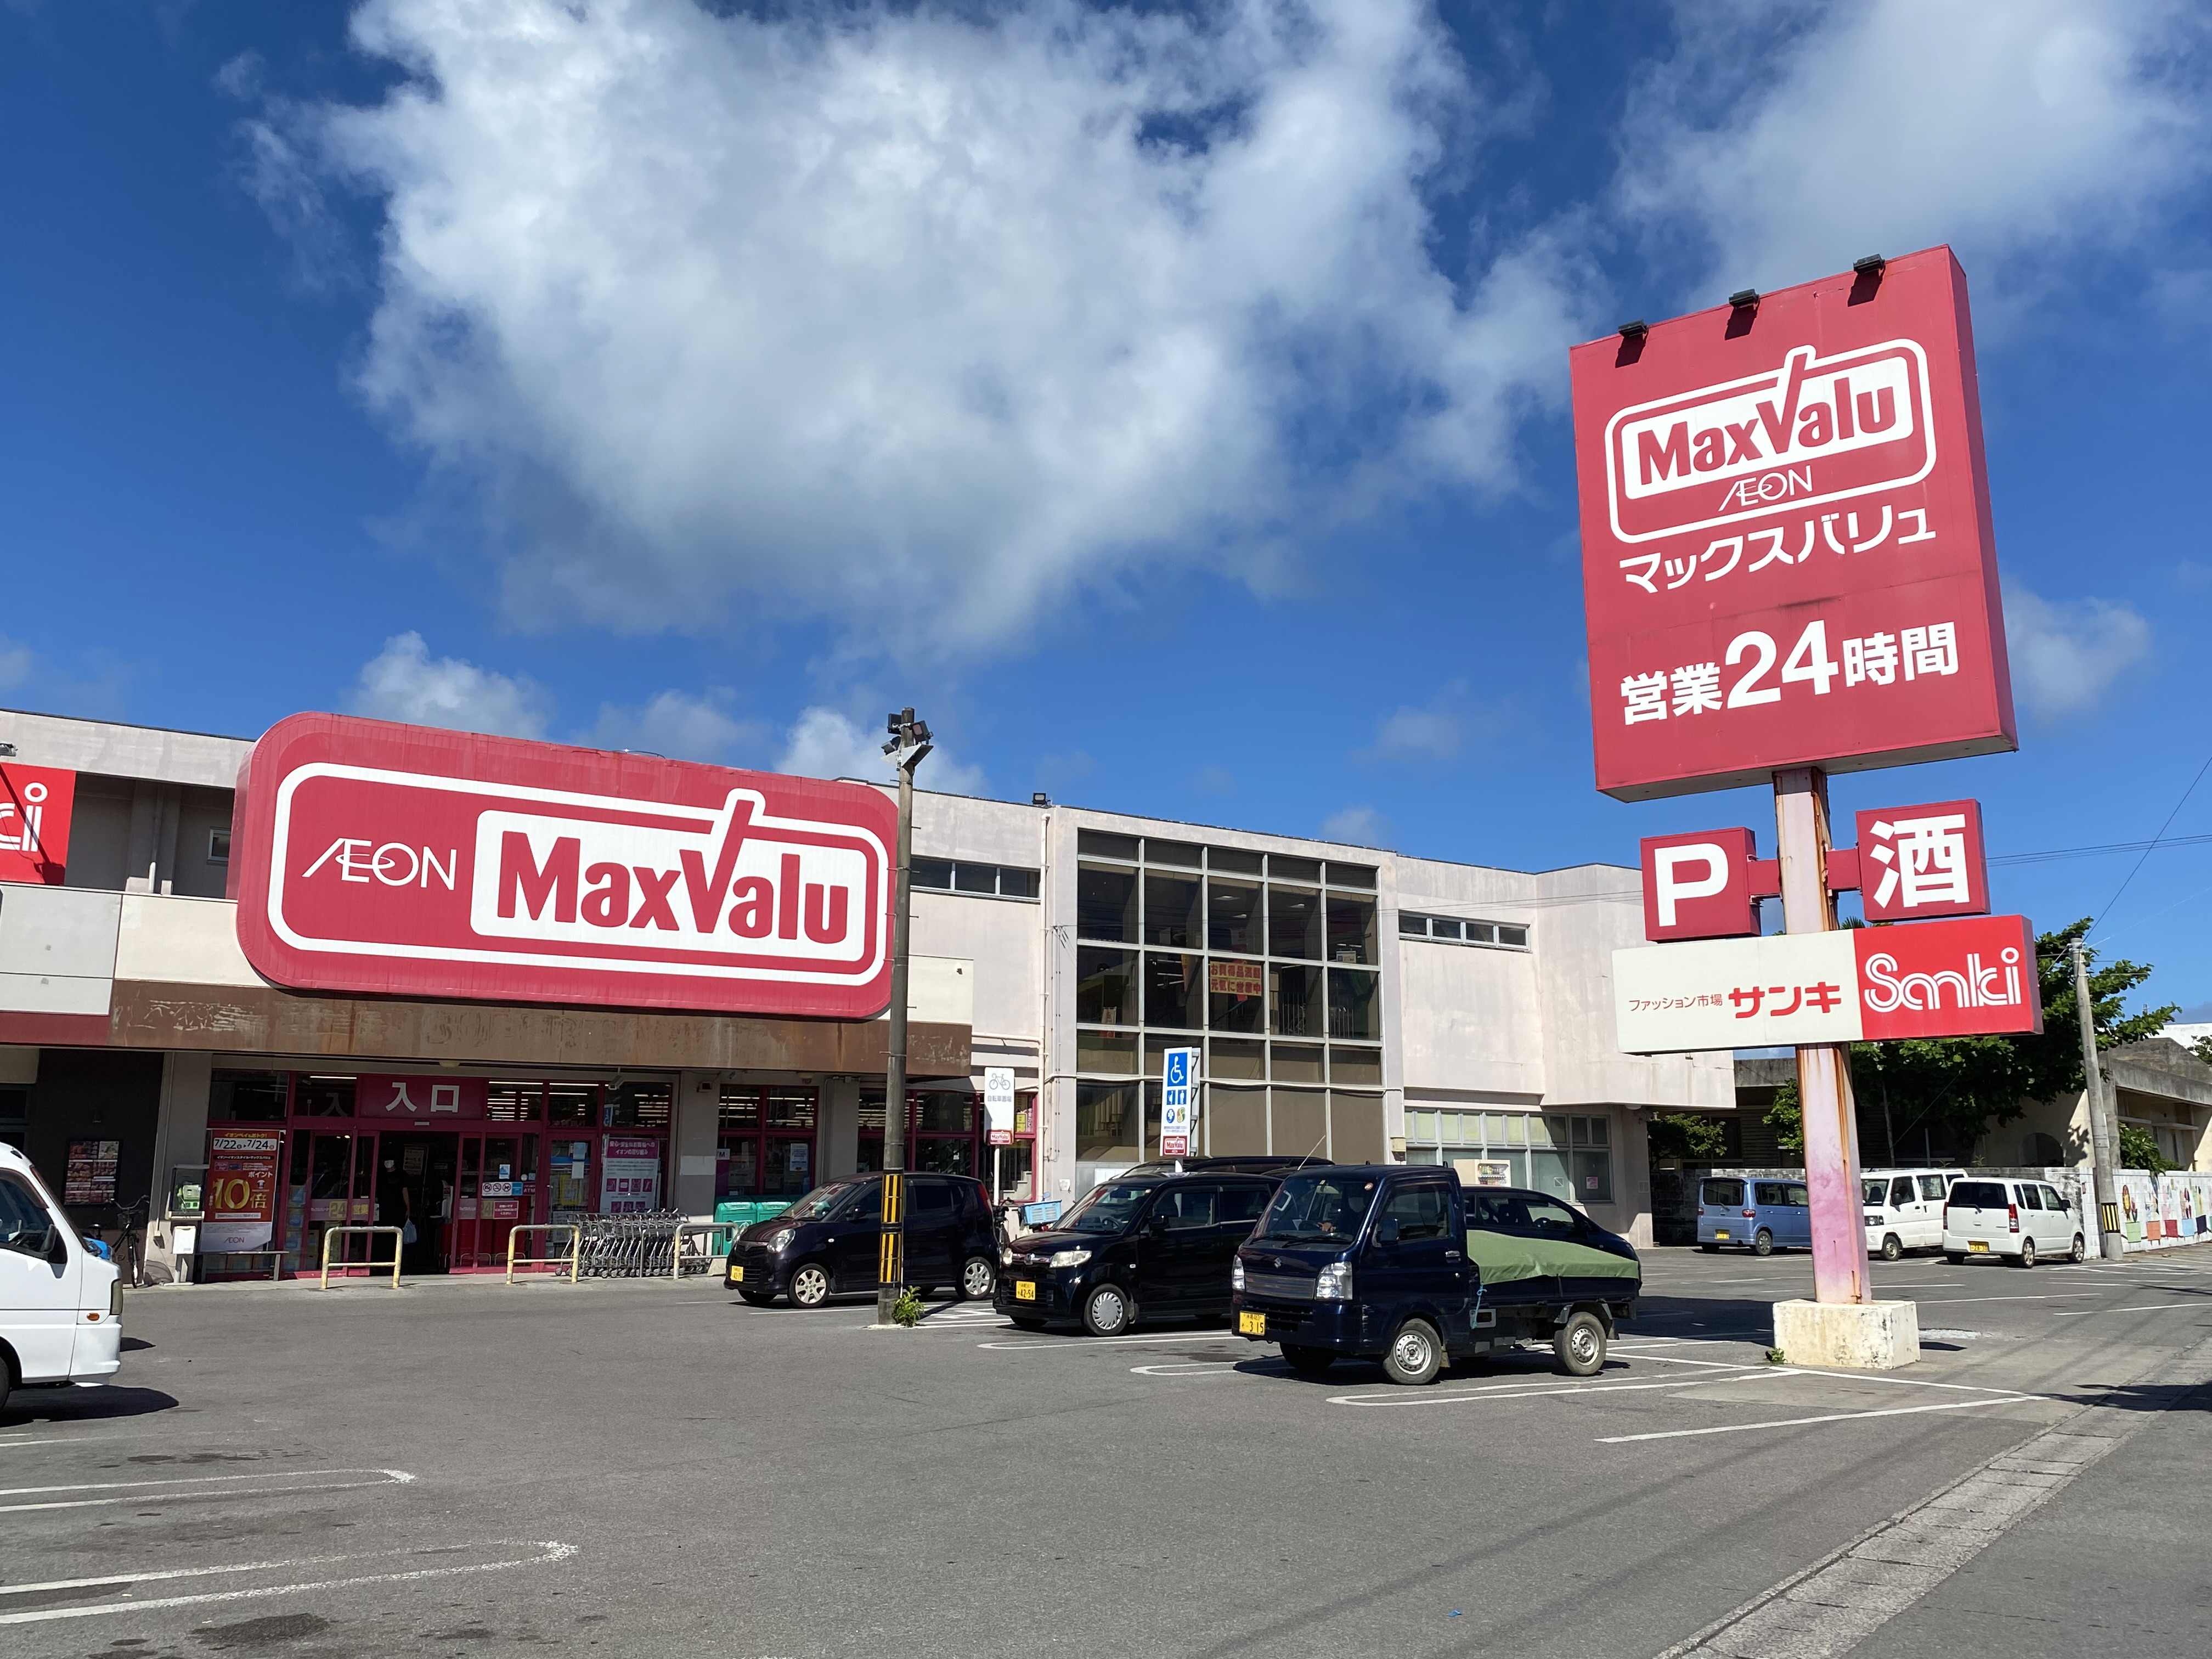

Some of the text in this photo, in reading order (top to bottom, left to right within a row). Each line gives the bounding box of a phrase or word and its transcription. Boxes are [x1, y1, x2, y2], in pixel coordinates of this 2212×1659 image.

[1638, 353, 1897, 486] MaxValu
[1619, 505, 1937, 594] マックスバリュ
[1620, 619, 1960, 725] 営業24時間
[497, 799, 848, 944] MaxValu
[1654, 843, 1729, 927] P
[1870, 814, 1971, 909] 酒
[1628, 981, 1842, 1019] ファッション市場 サンキ
[1865, 951, 2022, 1013] Sanki
[385, 1082, 460, 1113] 入口
